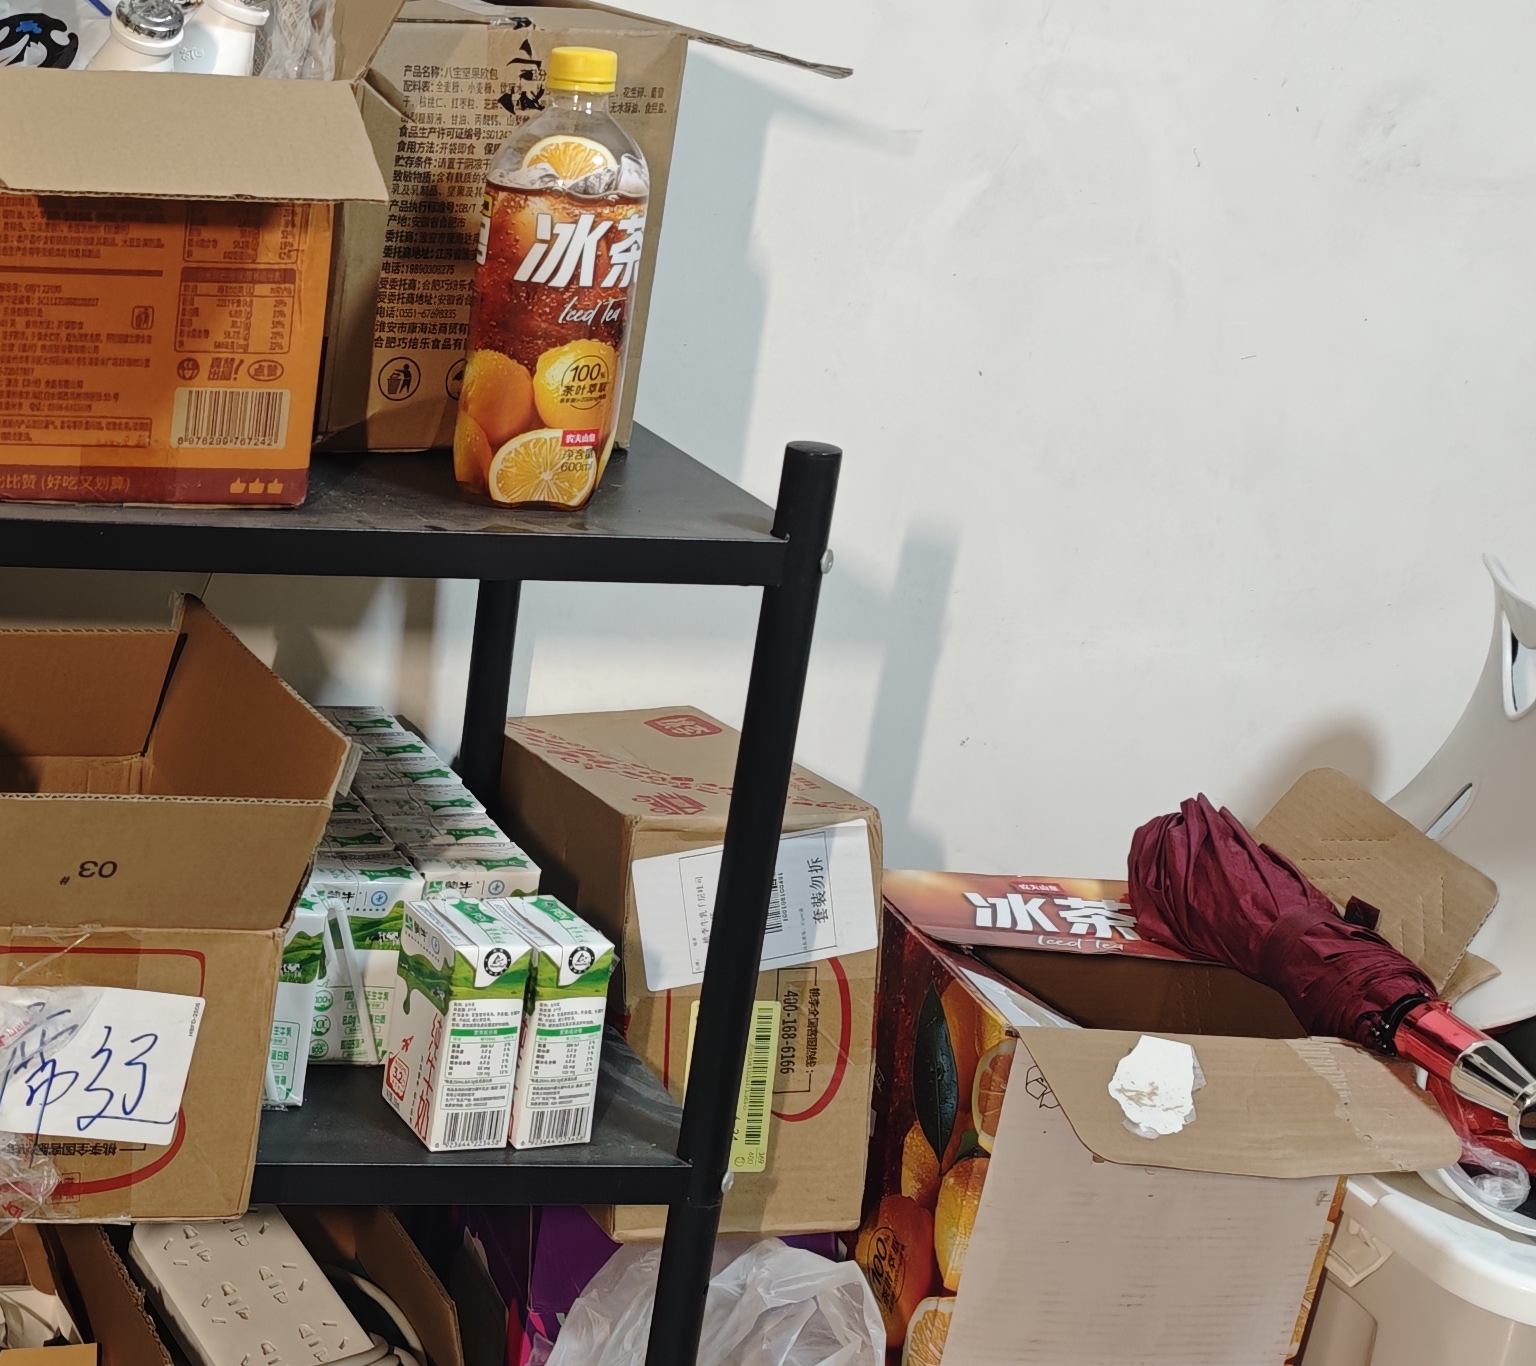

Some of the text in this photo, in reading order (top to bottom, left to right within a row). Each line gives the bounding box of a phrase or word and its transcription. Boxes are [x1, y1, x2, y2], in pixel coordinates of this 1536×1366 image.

[558, 296, 627, 325] Iced Tea
[559, 458, 595, 474] 600ml
[562, 448, 594, 462] 净含量
[810, 855, 830, 926] 套装勿拆
[967, 891, 1139, 941] 冰茶
[1035, 932, 1082, 950] Iced
[780, 989, 799, 1076] 400-168-6166
